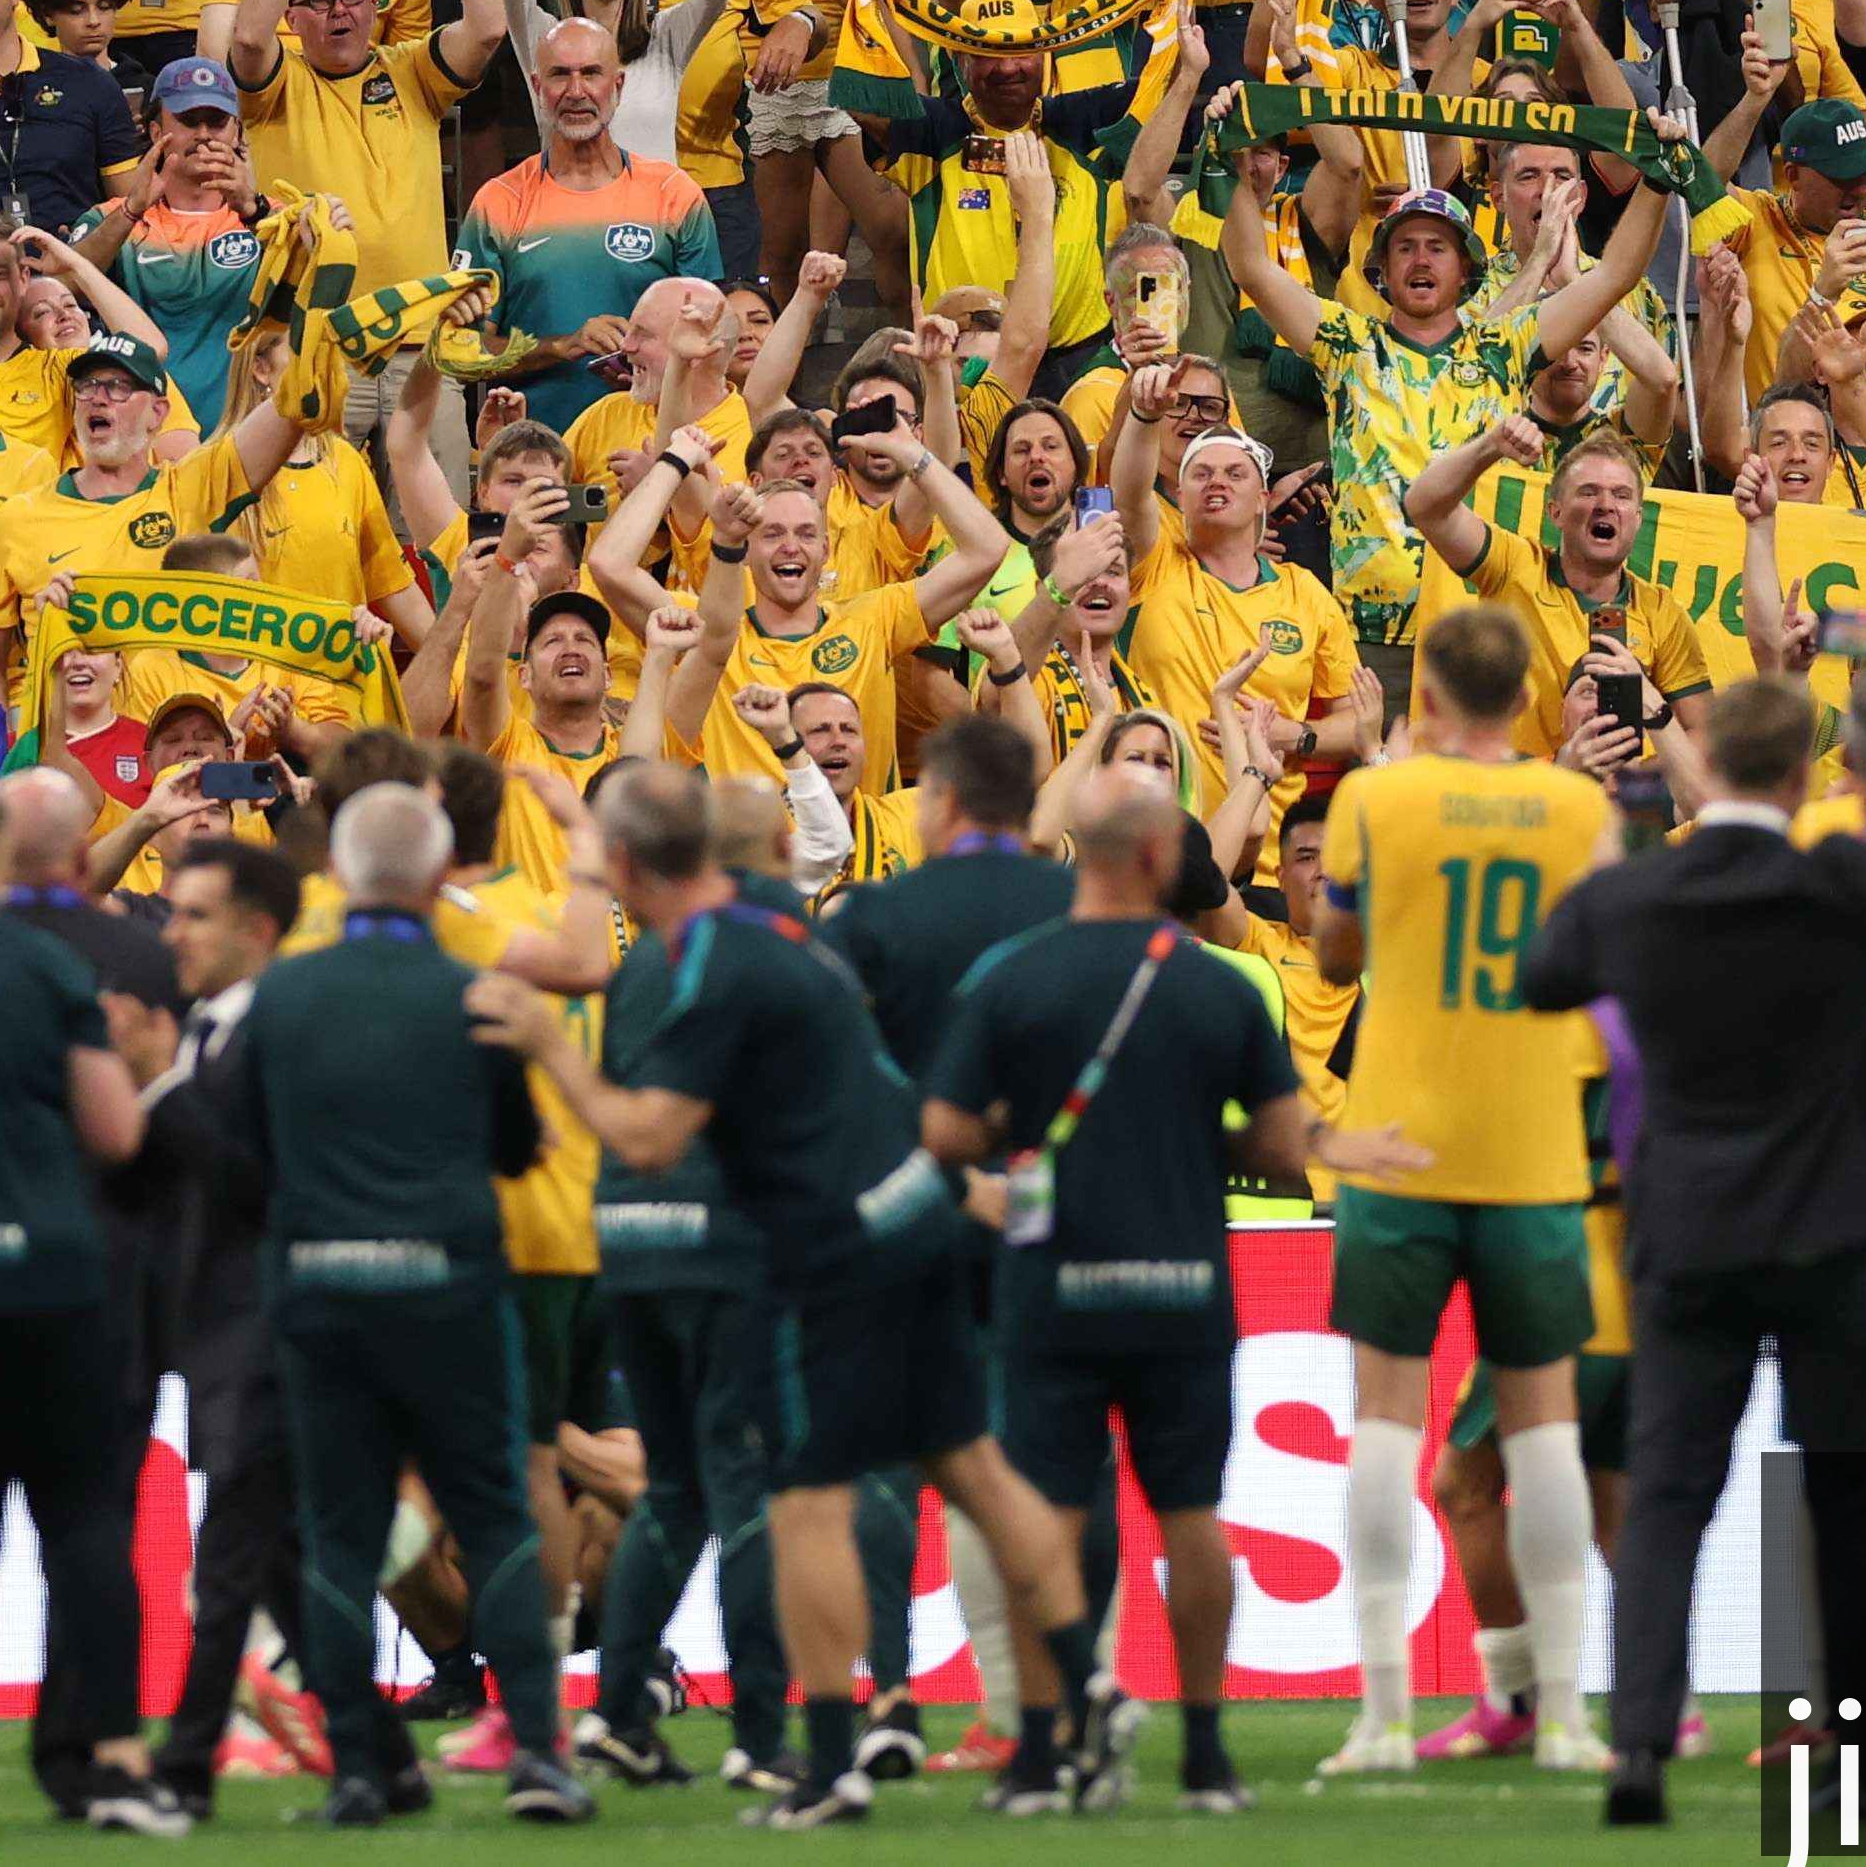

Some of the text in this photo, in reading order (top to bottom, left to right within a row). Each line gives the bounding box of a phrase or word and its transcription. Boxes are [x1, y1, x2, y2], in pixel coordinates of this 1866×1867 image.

[977, 0, 1015, 22] AUS
[1088, 10, 1120, 32] CUP
[69, 589, 376, 671] SOCCEROOS
[1435, 856, 1545, 1013] 19
